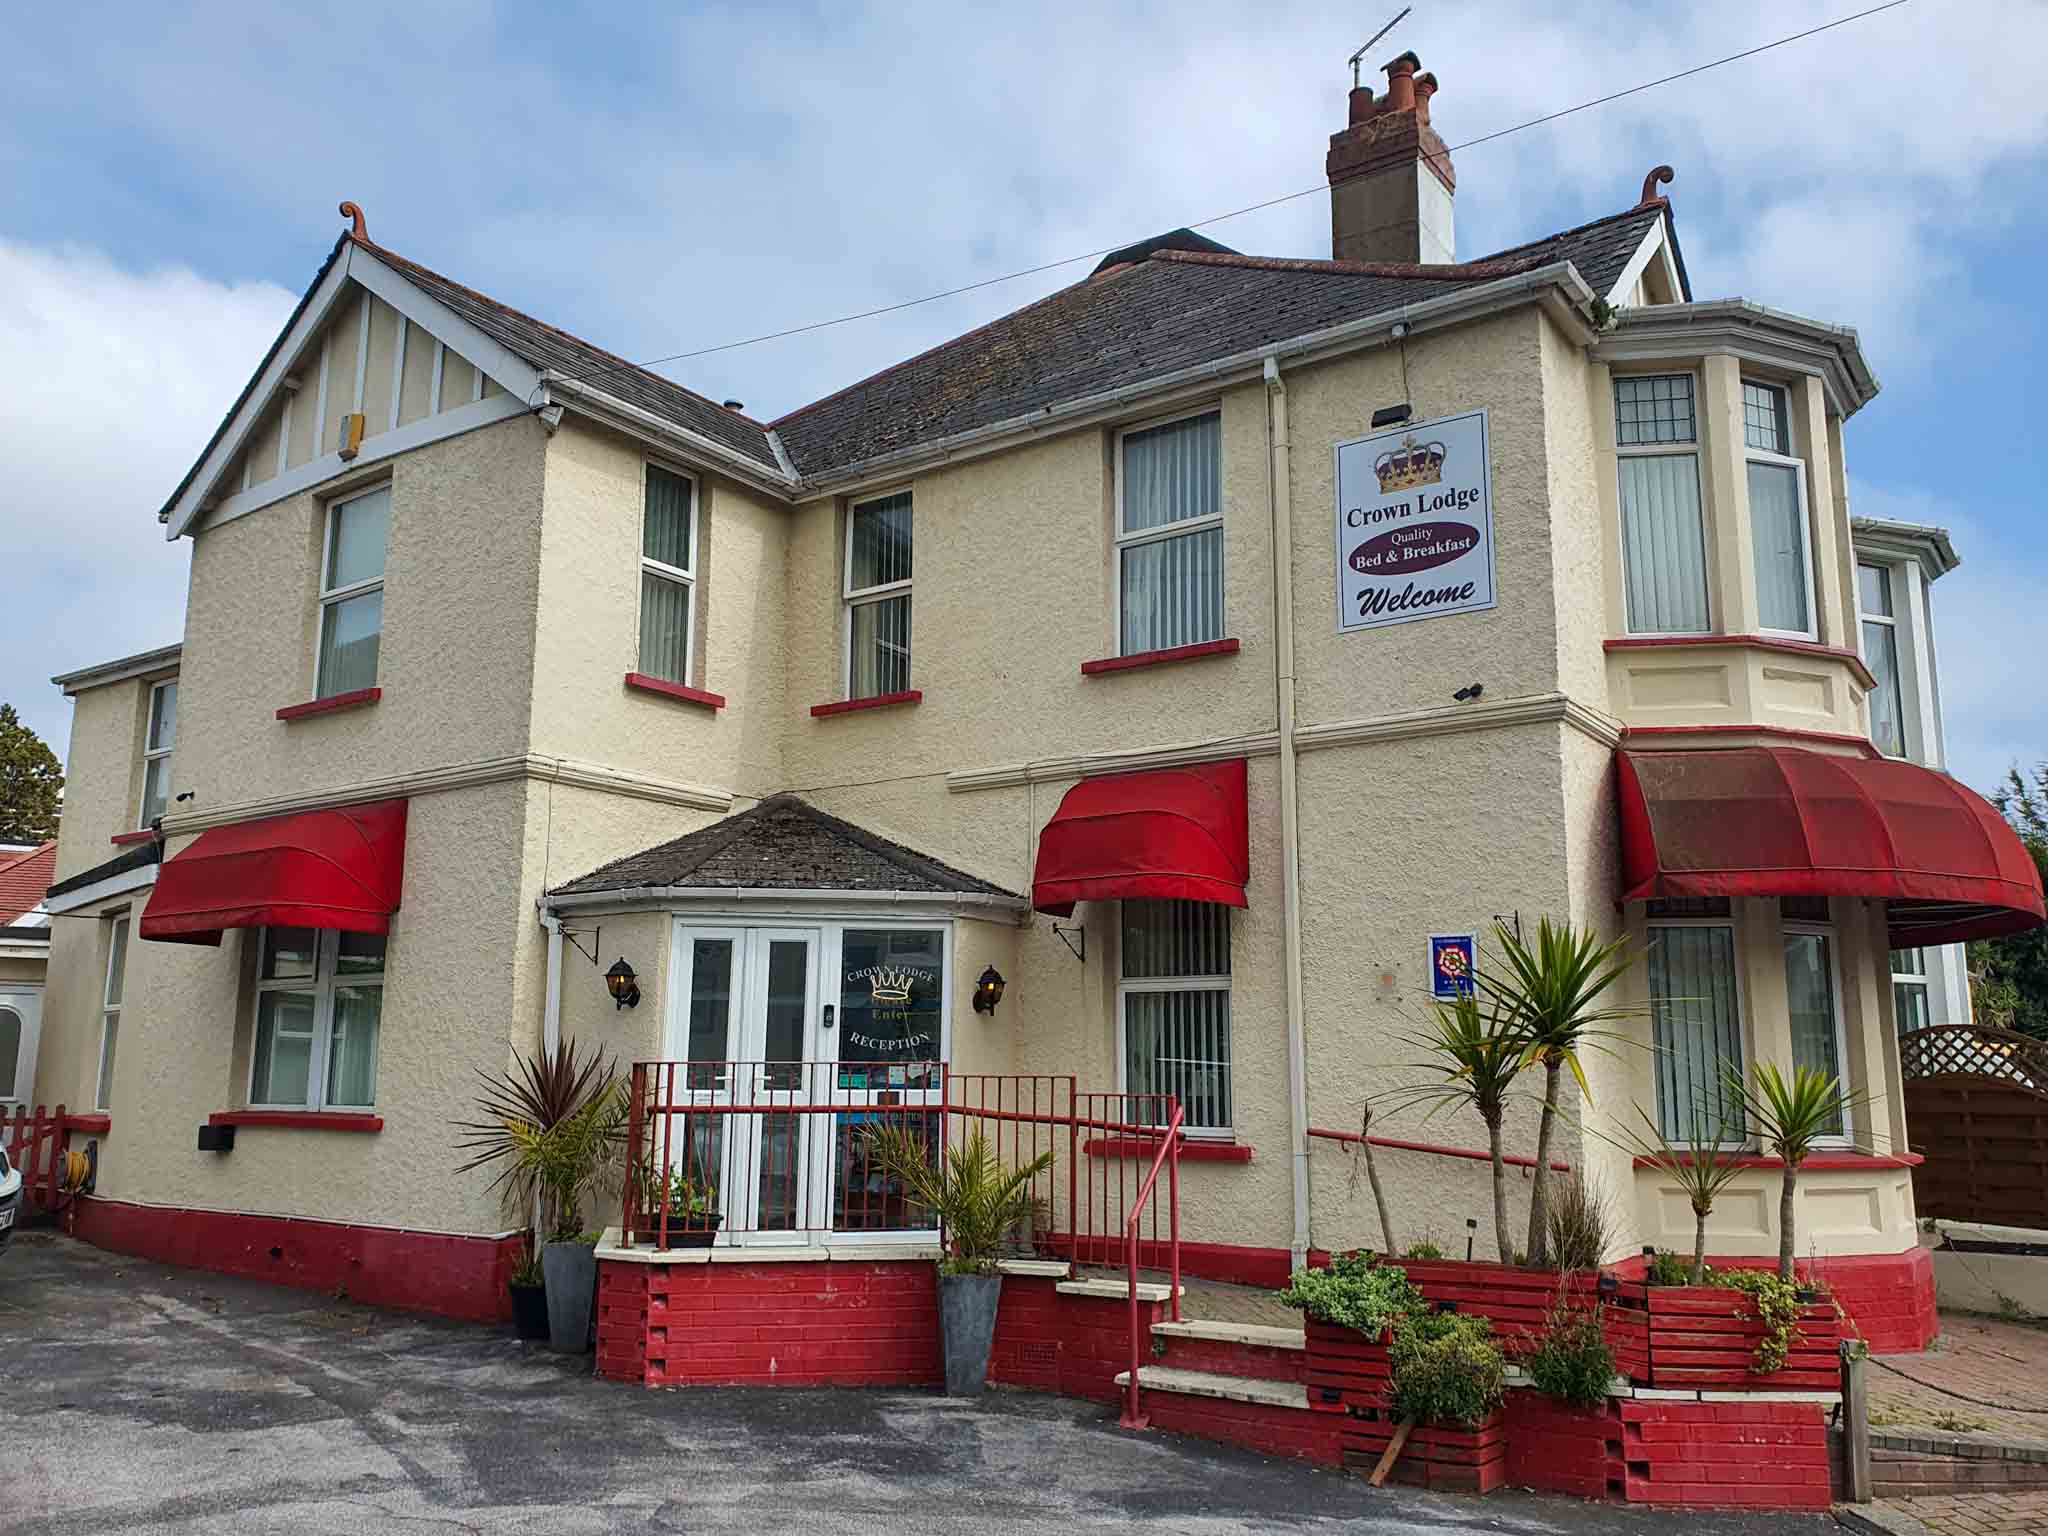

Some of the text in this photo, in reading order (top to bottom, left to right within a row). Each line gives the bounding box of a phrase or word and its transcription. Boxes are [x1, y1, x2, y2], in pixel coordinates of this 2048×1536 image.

[1347, 488, 1479, 527] Crown Lodge
[1391, 528, 1433, 545] Quality
[1356, 537, 1471, 570] Bed & Breakfast
[1356, 582, 1476, 616] Welcome
[847, 965, 936, 982] CROWN LODGE
[850, 1031, 931, 1050] RECEPTION
